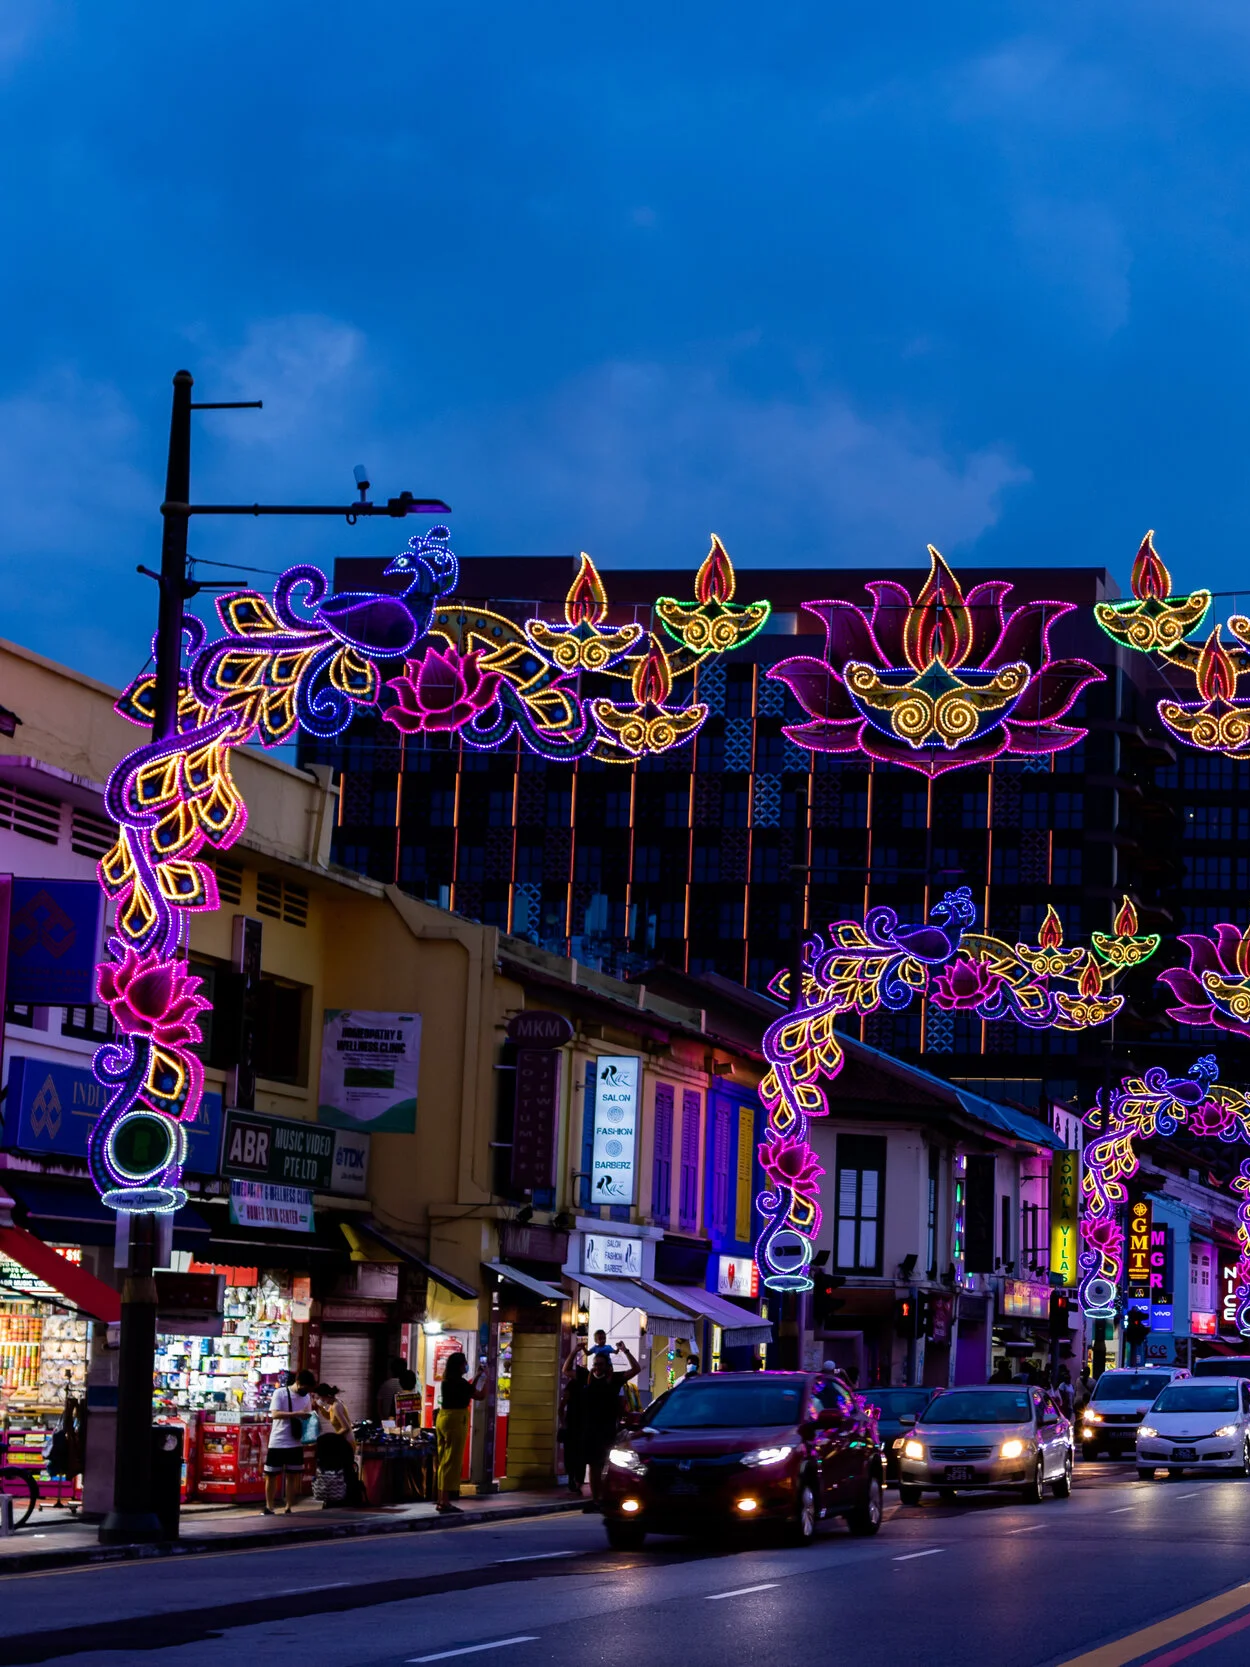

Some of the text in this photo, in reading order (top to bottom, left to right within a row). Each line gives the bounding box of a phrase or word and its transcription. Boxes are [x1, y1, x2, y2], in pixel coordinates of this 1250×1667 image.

[517, 1019, 560, 1038] MKM
[337, 1040, 406, 1054] WELLNESS CLINIC
[602, 1094, 631, 1102] SALON
[275, 1127, 332, 1157] MUSIC VIDEO
[596, 1128, 633, 1136] FASHION
[229, 1127, 269, 1166] ABR
[343, 1147, 365, 1169] TDK
[283, 1156, 300, 1179] PTE
[301, 1158, 318, 1180] LTD
[594, 1161, 632, 1170] BARBERZ
[1060, 1151, 1073, 1220] KOMALA
[1060, 1225, 1071, 1283] VILAS
[1131, 1218, 1149, 1268] GMT
[604, 1251, 622, 1261] FASHION
[1150, 1231, 1165, 1288] MGR
[1223, 1266, 1238, 1321] NICE
